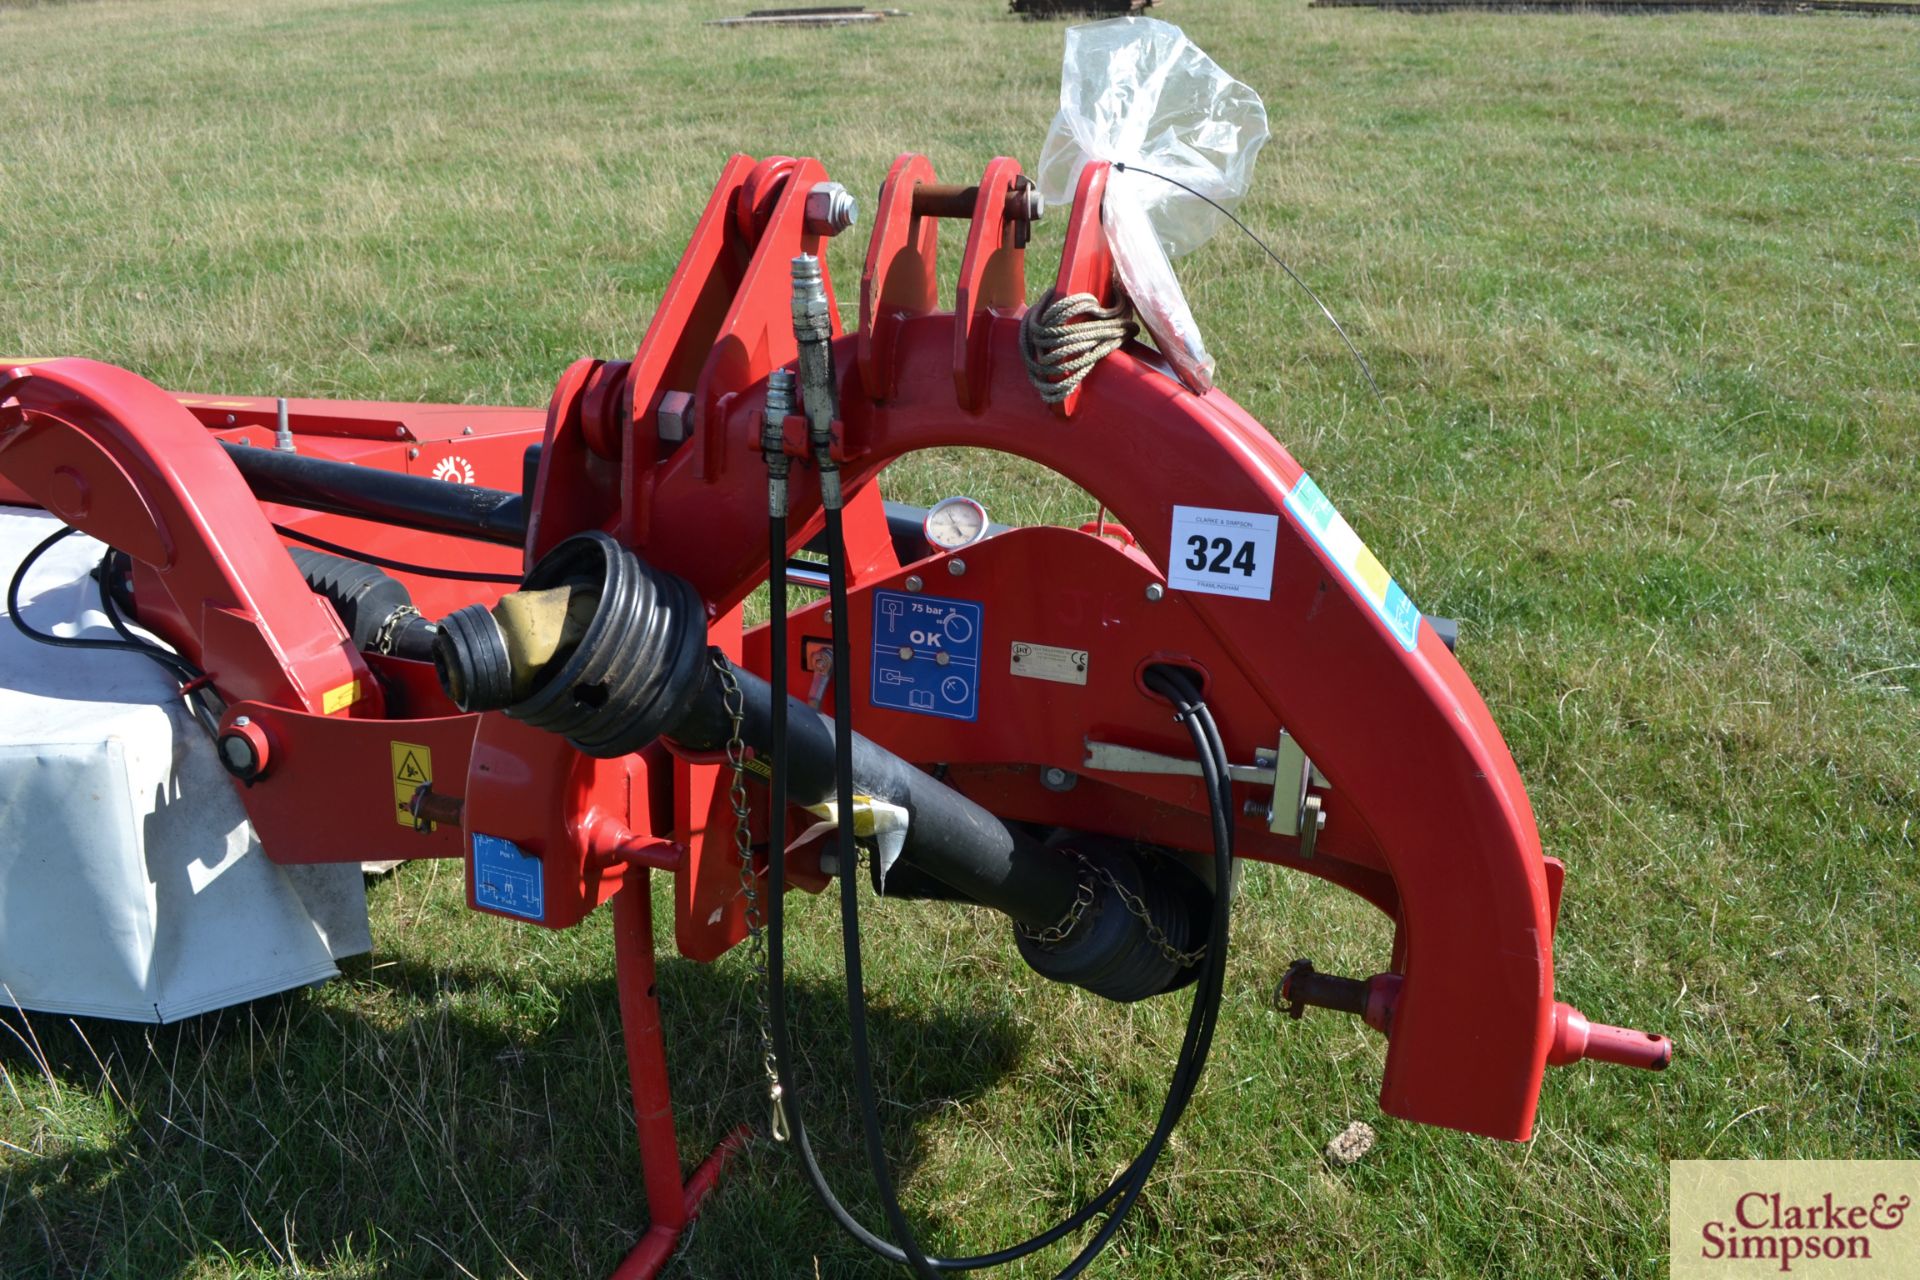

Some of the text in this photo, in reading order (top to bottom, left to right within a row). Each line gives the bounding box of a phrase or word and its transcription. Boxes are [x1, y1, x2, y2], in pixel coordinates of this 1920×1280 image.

[1195, 516, 1218, 525] CLARKE
[1226, 519, 1253, 529] SIMPSON
[1185, 534, 1256, 577] 324
[911, 603, 924, 613] 75
[926, 605, 943, 615] bar
[909, 630, 942, 648] OK
